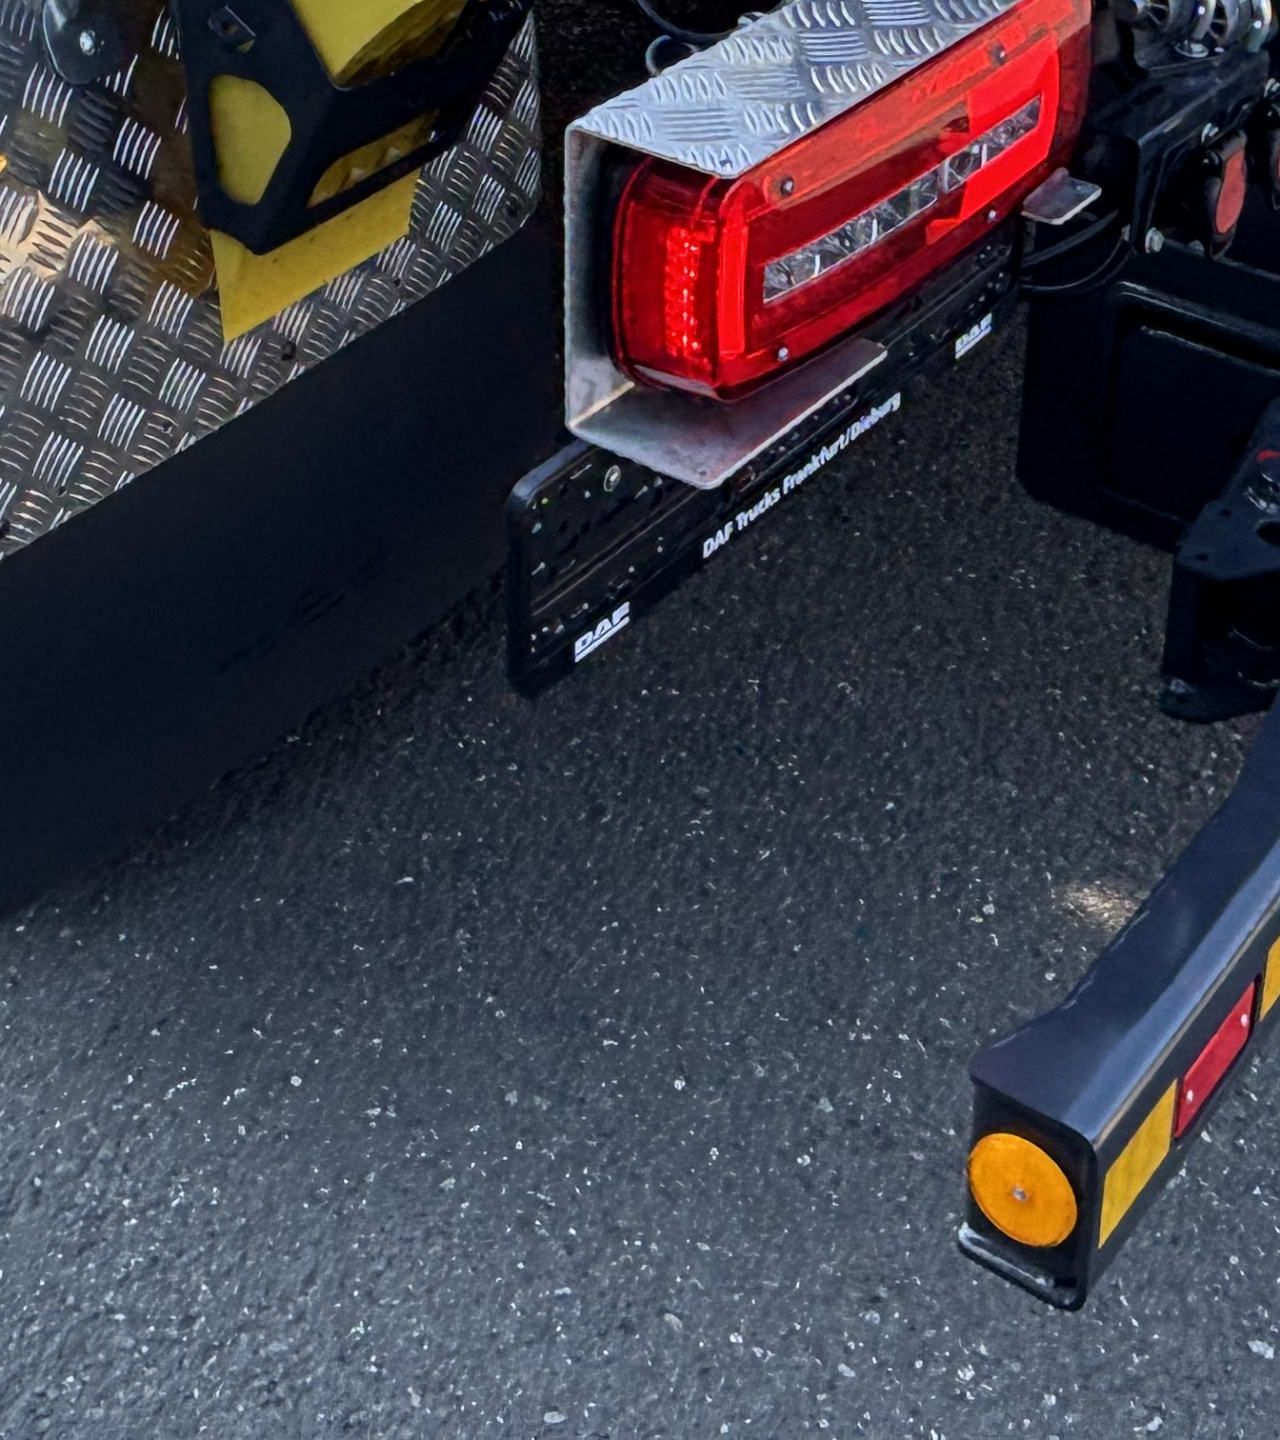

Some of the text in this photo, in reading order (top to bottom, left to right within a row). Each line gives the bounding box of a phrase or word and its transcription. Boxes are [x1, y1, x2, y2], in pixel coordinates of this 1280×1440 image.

[955, 312, 992, 354] DAF
[702, 391, 902, 559] DAF Trucks Frankfurt/Dieburg
[574, 601, 631, 657] DAF
